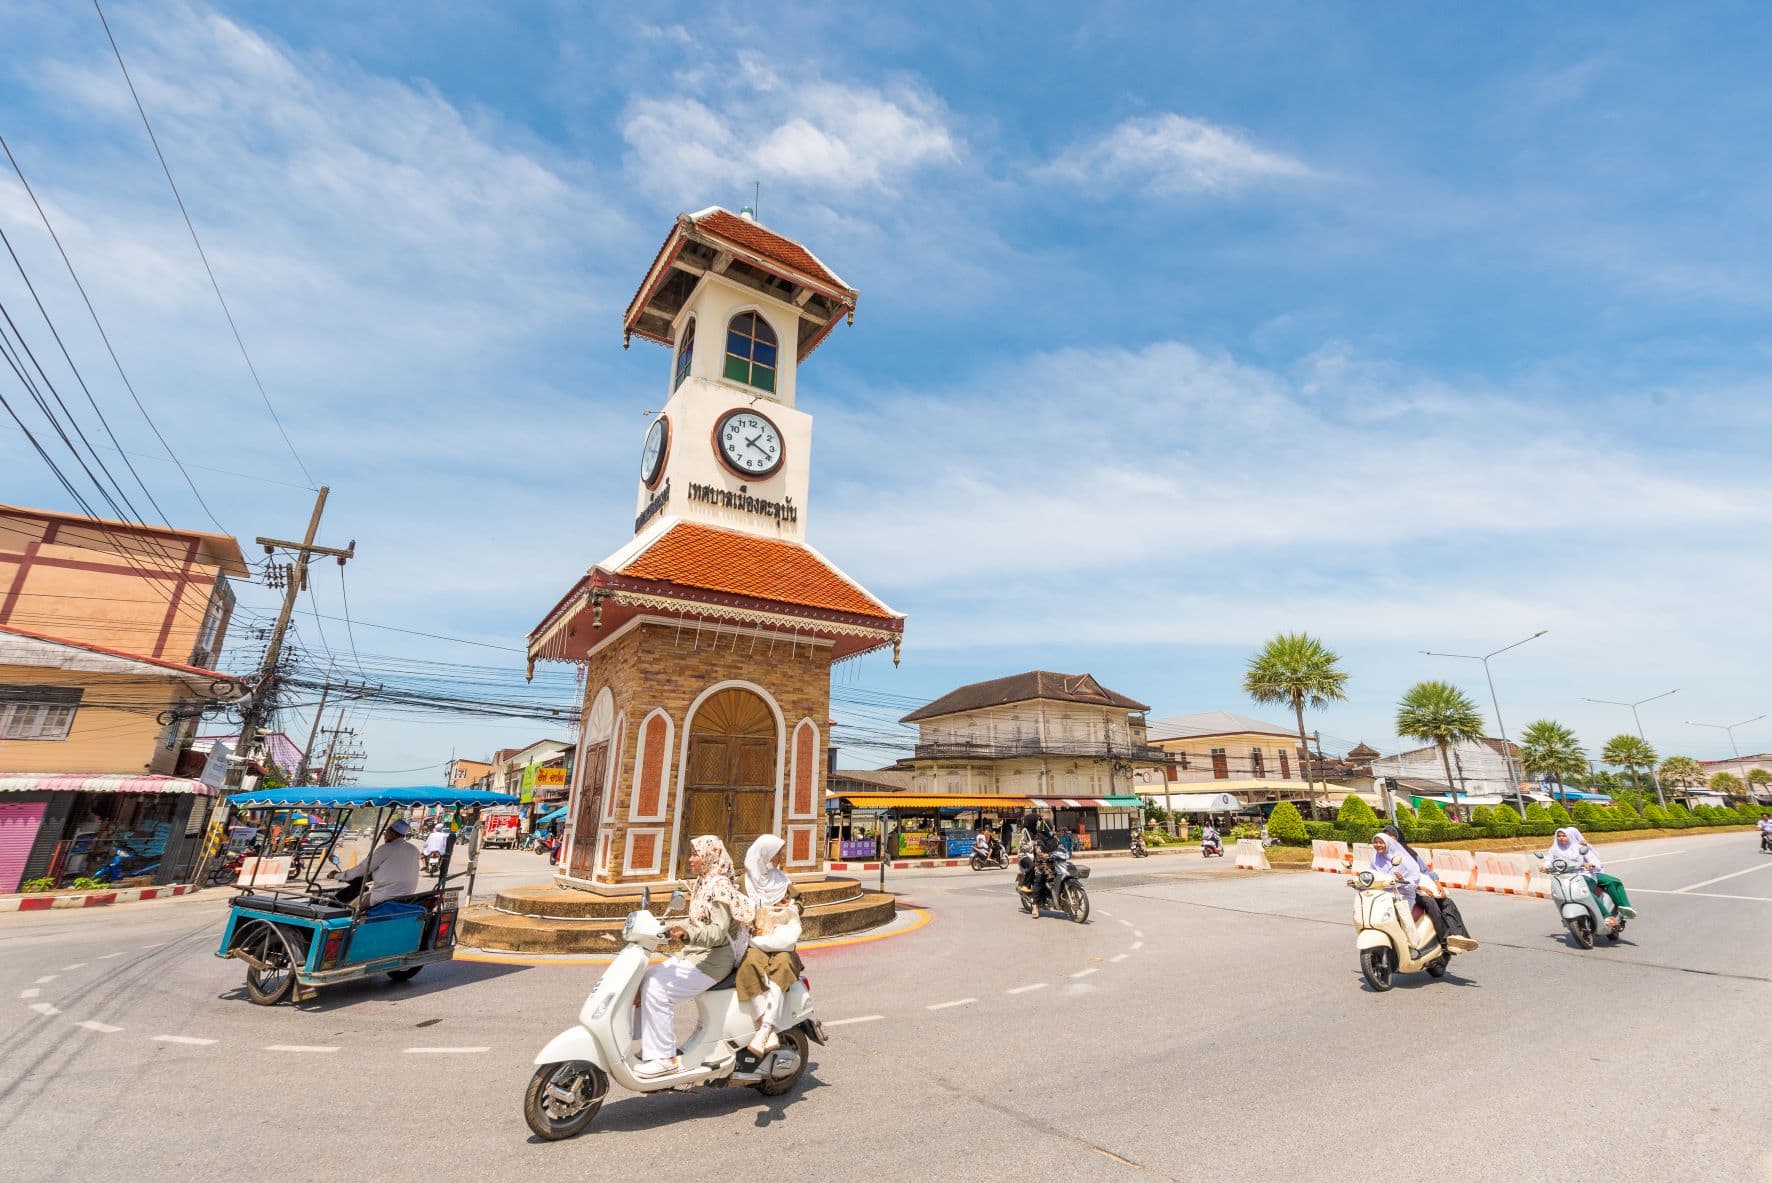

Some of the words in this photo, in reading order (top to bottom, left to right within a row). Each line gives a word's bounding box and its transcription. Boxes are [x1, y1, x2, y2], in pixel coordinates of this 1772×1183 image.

[737, 418, 746, 428] 11
[748, 420, 758, 429] 12
[730, 425, 740, 434] 10
[726, 433, 733, 441] 9
[766, 434, 773, 443] 2
[729, 444, 735, 452] 8
[769, 445, 775, 453] 3
[737, 453, 743, 461] 7
[746, 459, 753, 467] 6
[757, 459, 763, 467] 5
